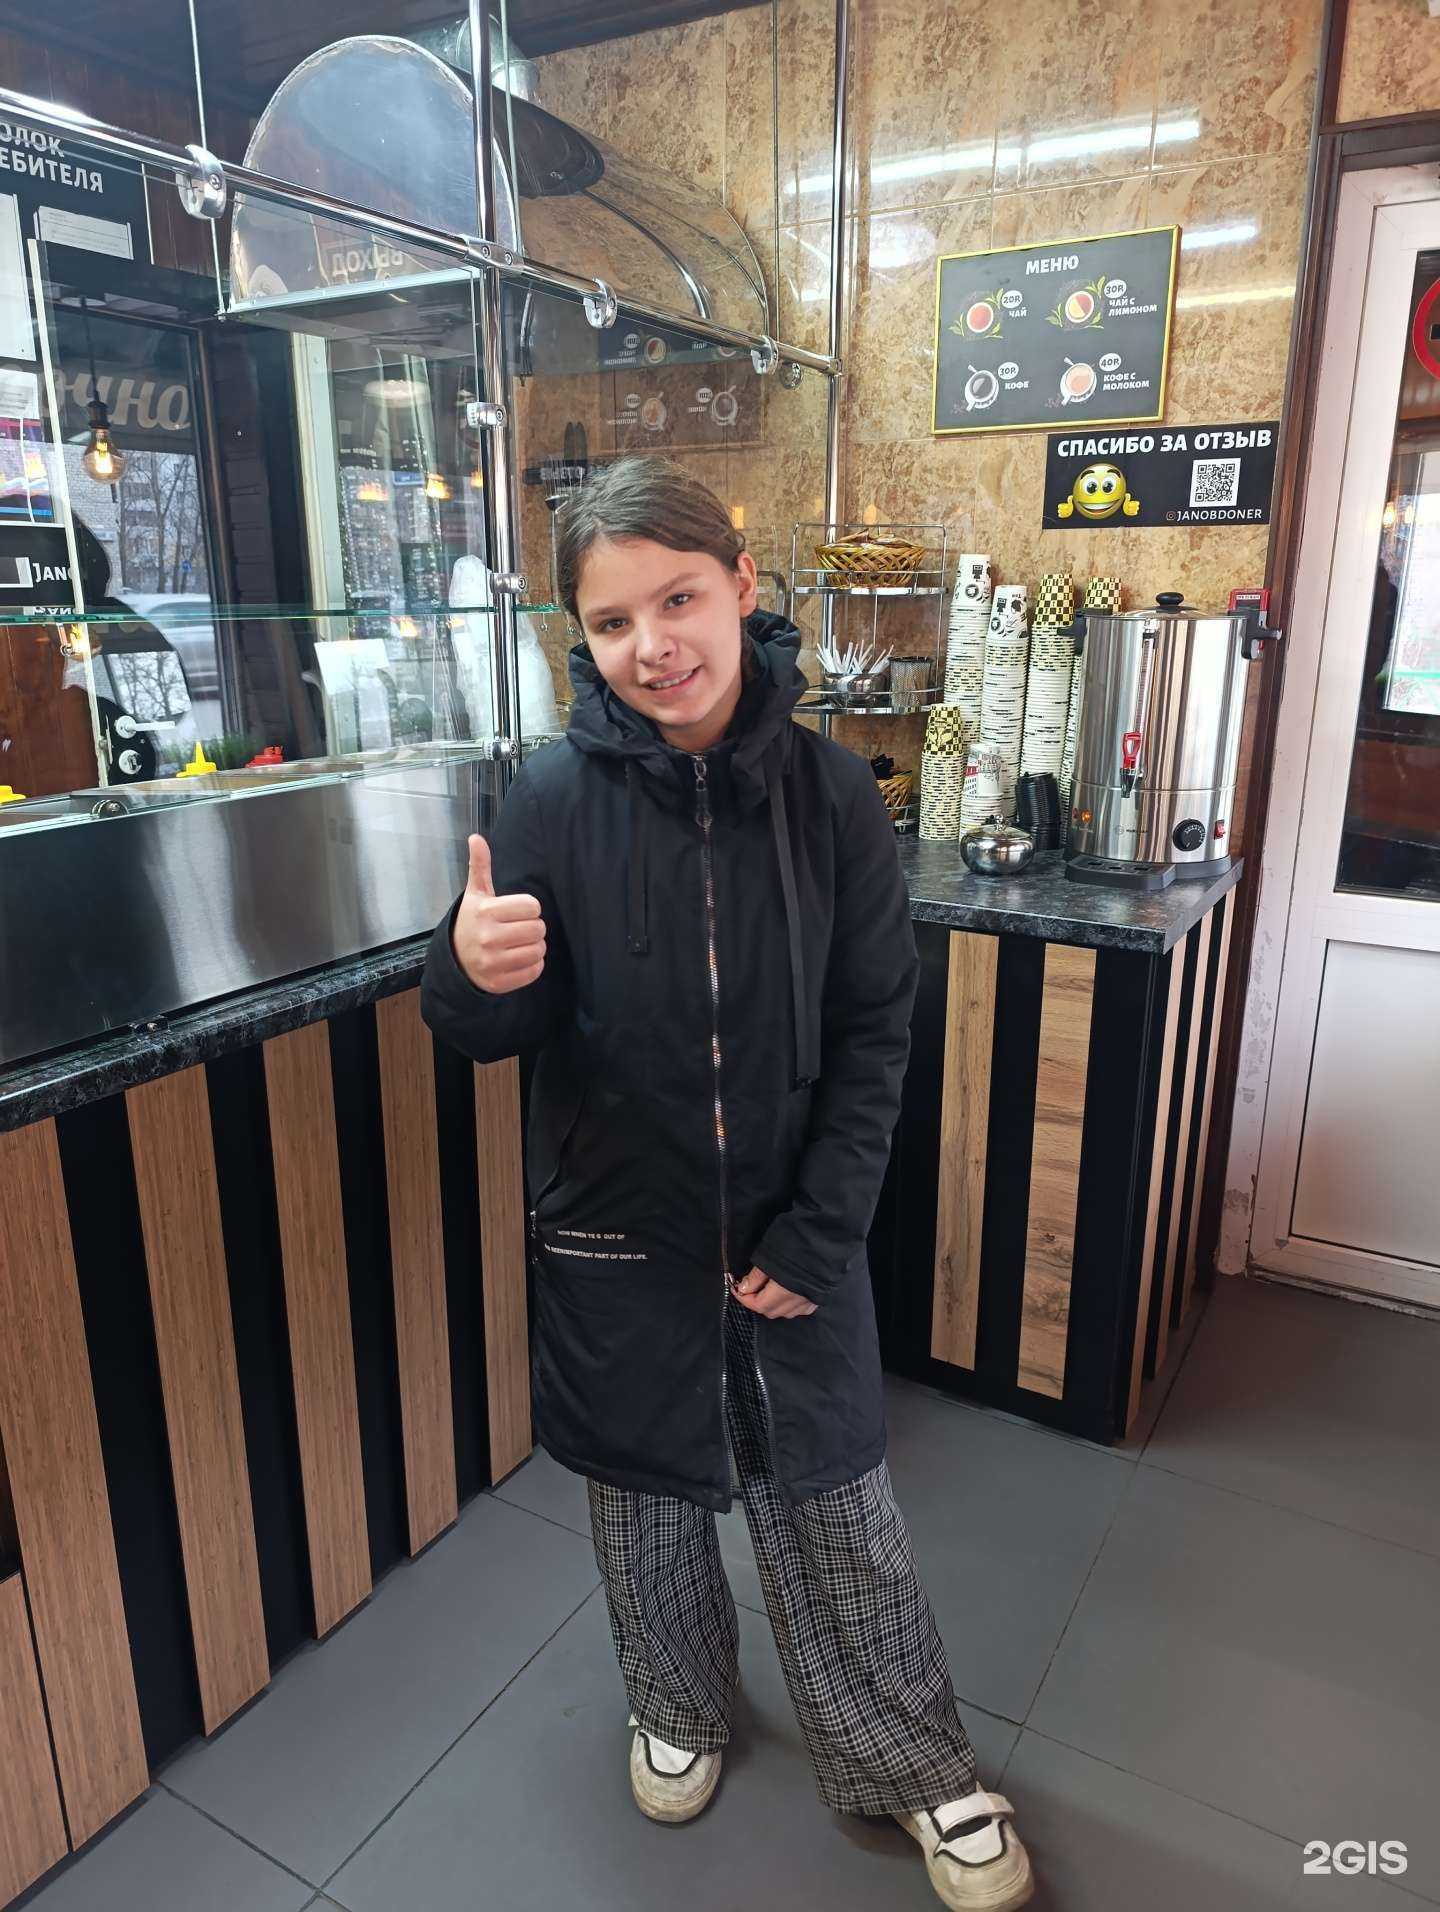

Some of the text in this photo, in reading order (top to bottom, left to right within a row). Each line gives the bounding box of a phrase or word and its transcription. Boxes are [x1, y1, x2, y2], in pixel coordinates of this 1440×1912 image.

[1025, 255, 1080, 275] МЕНЮ
[1108, 296, 1128, 307] ЧАЙ
[1009, 307, 1027, 318] ЧАЙ
[1108, 304, 1158, 317] ЛИМОНОМ
[1103, 373, 1130, 382] КОФЕ
[1004, 381, 1029, 390] КОФЕ
[1102, 380, 1150, 391] МОЛОКОМ
[1057, 429, 1272, 457] СПАСИБО ЗА ОТЗЫВ
[1176, 508, 1263, 522] JANOBDONER
